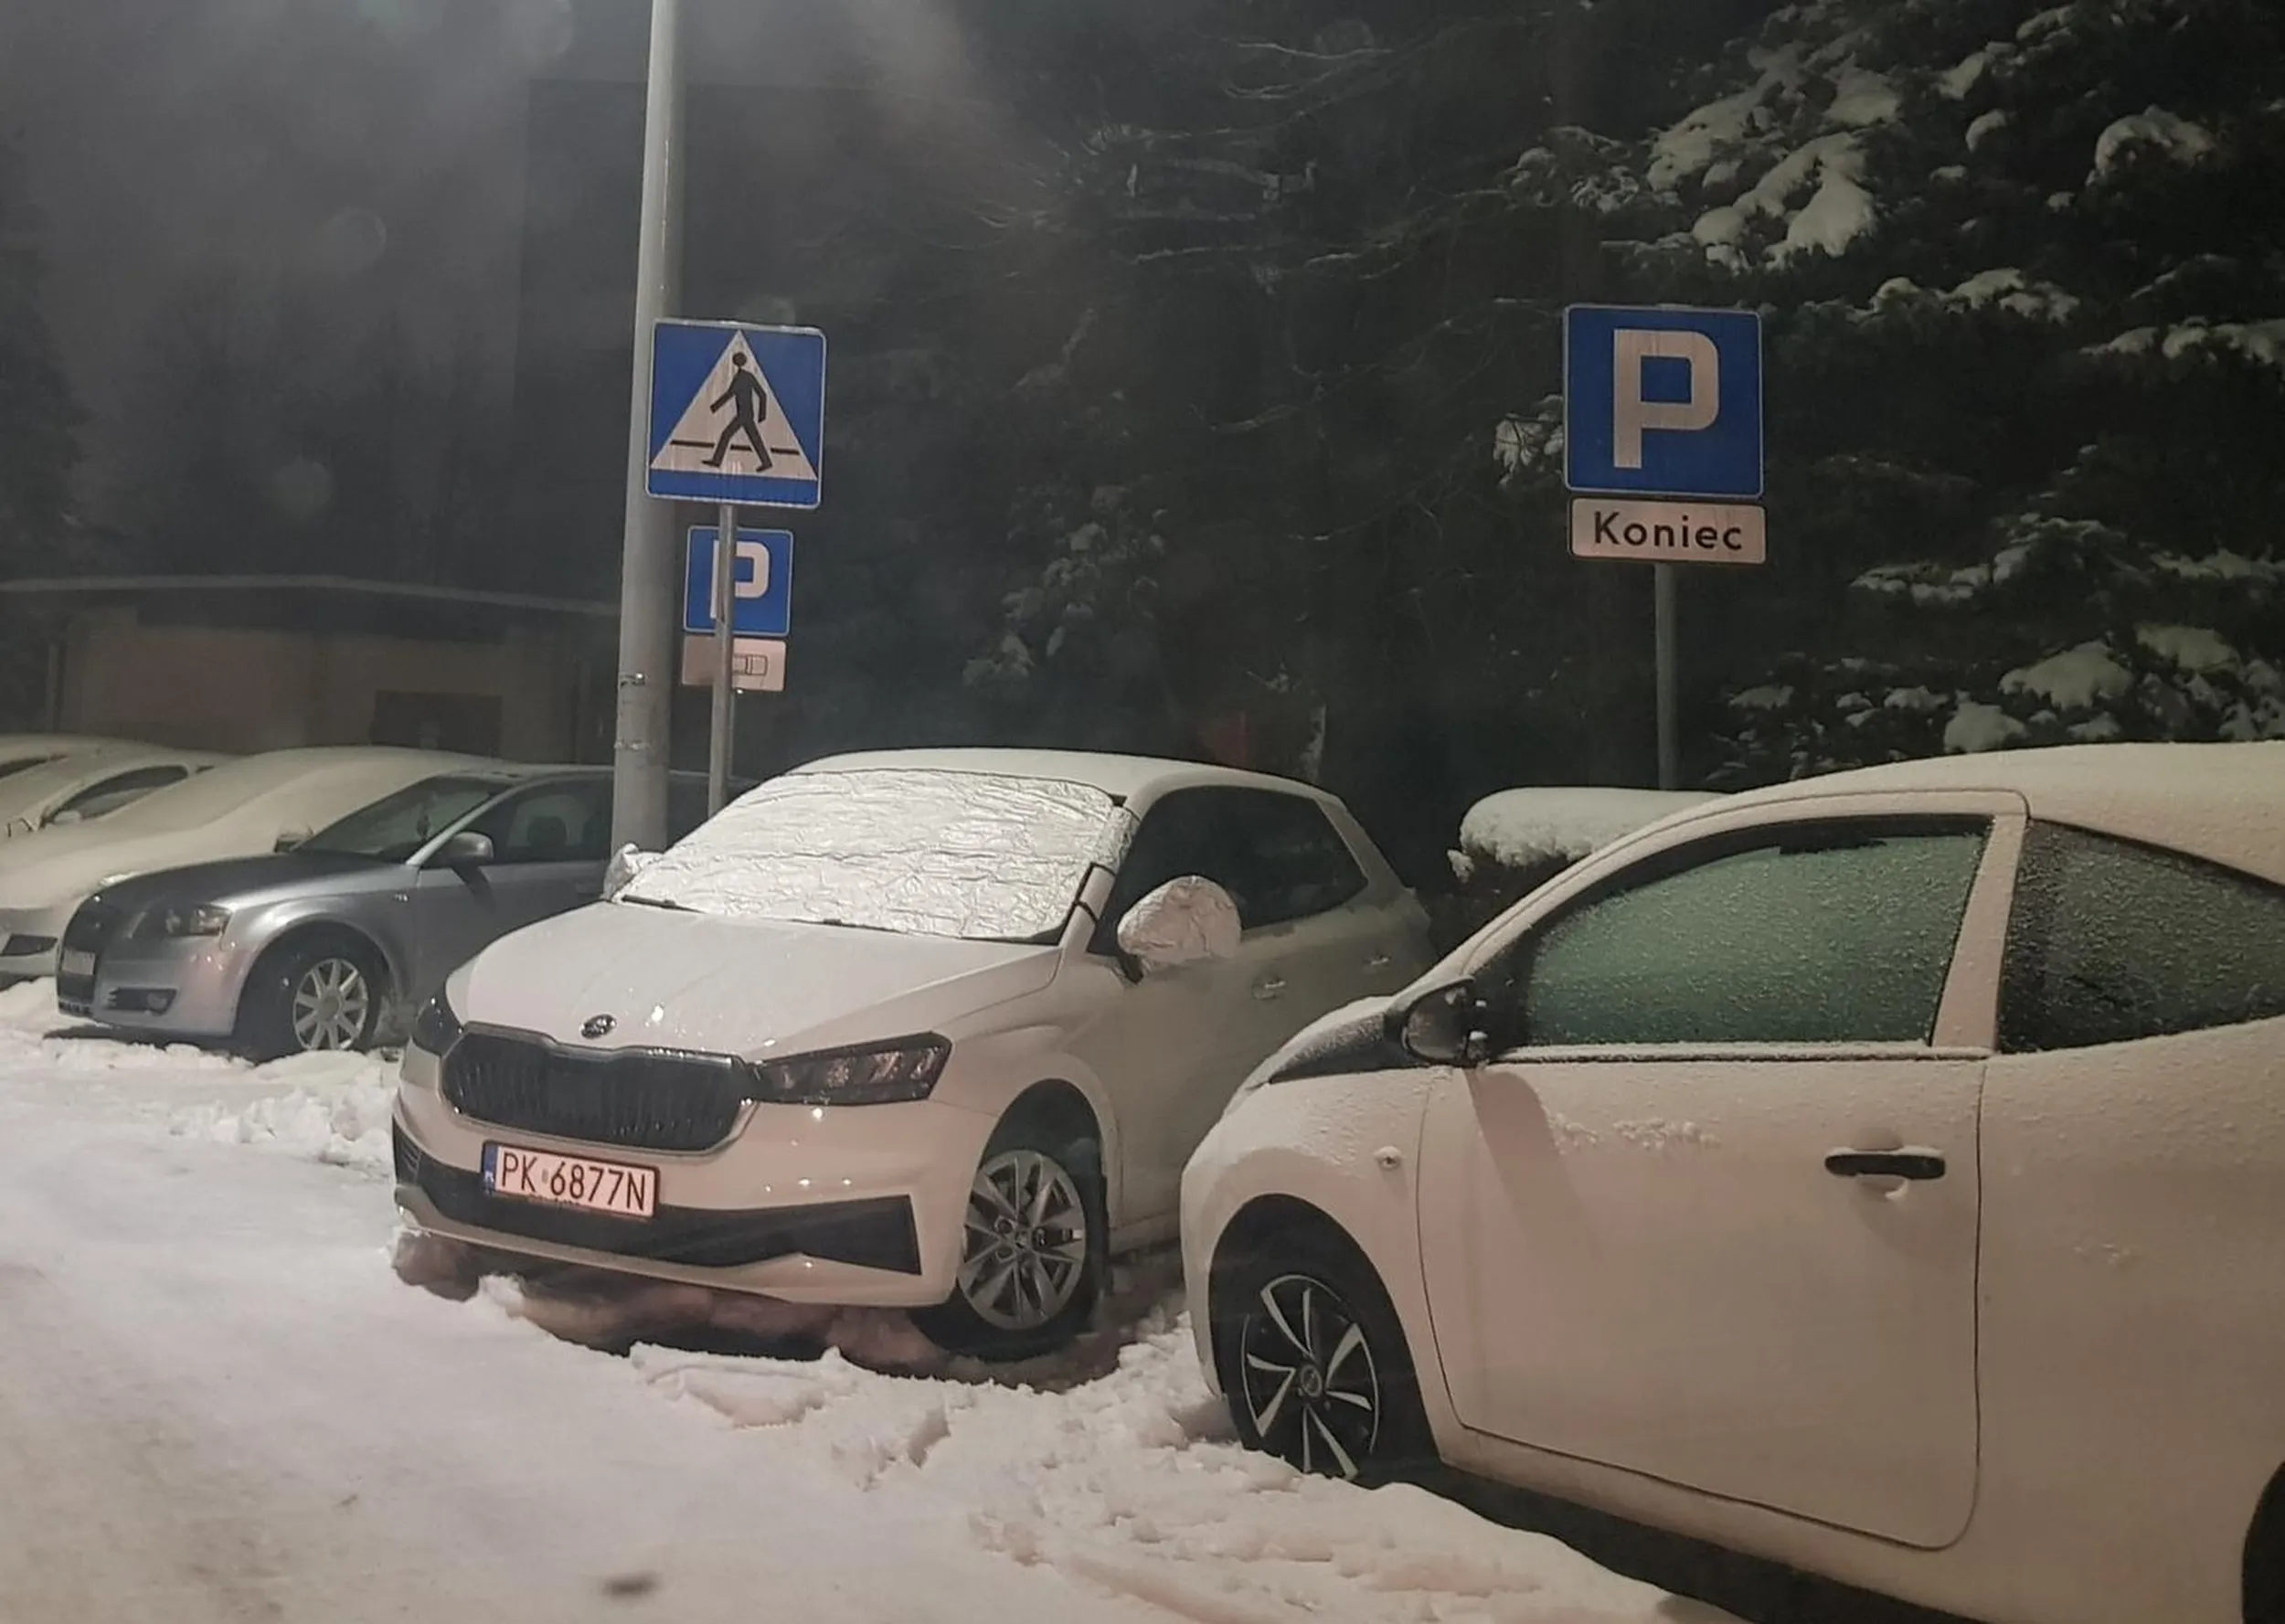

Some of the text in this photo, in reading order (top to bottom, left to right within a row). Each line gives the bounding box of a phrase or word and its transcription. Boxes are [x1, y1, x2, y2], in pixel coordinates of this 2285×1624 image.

[1613, 329, 1720, 469] P
[1594, 510, 1743, 551] Koniec
[710, 540, 770, 619] P
[502, 1152, 646, 1212] PK 6877N
